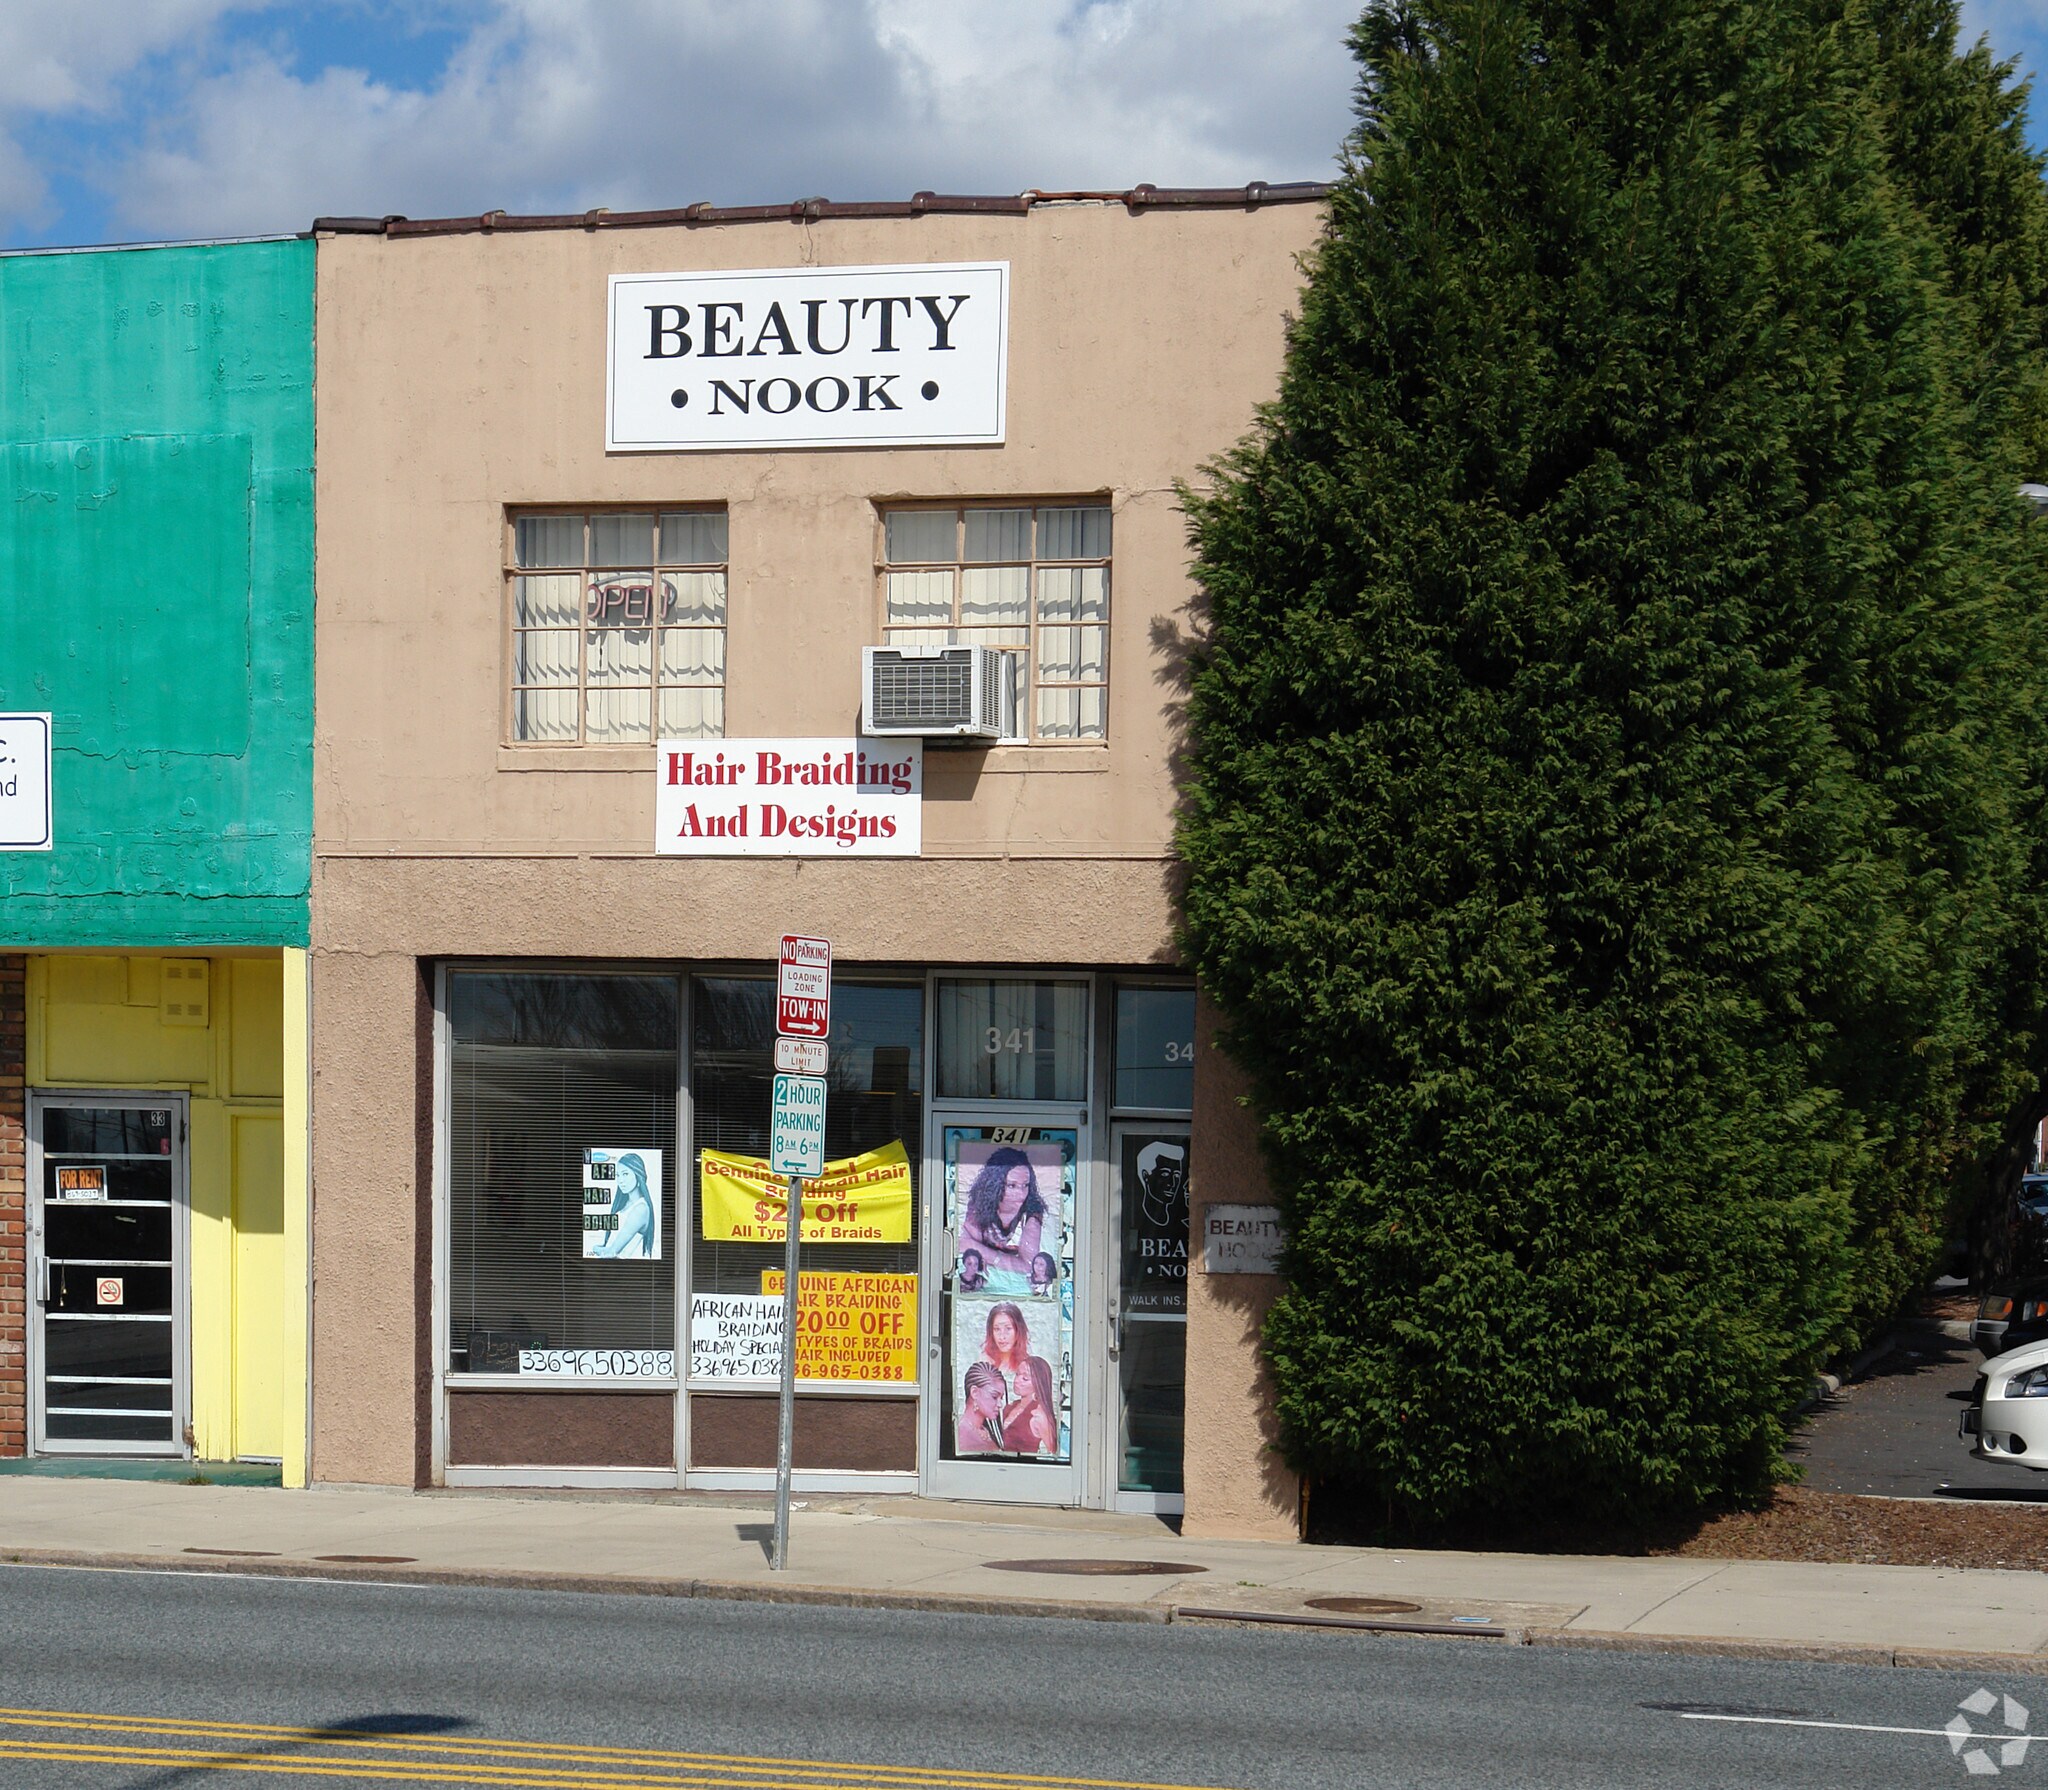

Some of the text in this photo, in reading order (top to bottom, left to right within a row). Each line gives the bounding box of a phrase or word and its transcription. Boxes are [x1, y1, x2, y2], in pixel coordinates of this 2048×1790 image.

[643, 294, 971, 359] BEAUTY
[707, 375, 903, 415] NOOK
[587, 584, 668, 620] OPEN
[666, 751, 913, 795] Hair Braiding
[677, 802, 897, 848] And Designs
[782, 940, 827, 961] NO PARKING
[788, 971, 823, 983] LOADING
[794, 983, 815, 993] ZONE
[781, 998, 826, 1020] TOW-IN
[984, 1026, 1035, 1054] 341
[781, 1044, 822, 1057] 10 MINUTE
[1164, 1041, 1194, 1062] 34
[791, 1057, 811, 1067] LIMIT
[776, 1080, 821, 1105] 2 HOUR
[152, 1111, 165, 1126] 33
[776, 1111, 821, 1132] PARKING
[776, 1135, 784, 1153] 8
[800, 1137, 808, 1155] 6
[993, 1128, 1028, 1144] 341
[60, 1169, 102, 1189] FOR RENT
[704, 1161, 783, 1183] Genuine
[866, 1166, 907, 1183] Hair
[583, 1187, 611, 1204] HAIR
[815, 1202, 858, 1222] Off
[731, 1225, 882, 1240] All Typs of Braids
[1209, 1220, 1280, 1237] BEAUTY
[768, 1275, 915, 1294] GEUINE AFRICAN
[692, 1299, 784, 1320] AFRICAN HAI
[826, 1294, 902, 1309] BRAIDING
[1128, 1295, 1158, 1306] WALK
[860, 1312, 905, 1336] OFF
[797, 1336, 913, 1351] TYPES OF BRAIDS
[522, 1350, 672, 1376] 3369650388
[829, 1350, 891, 1363] INCLUDED
